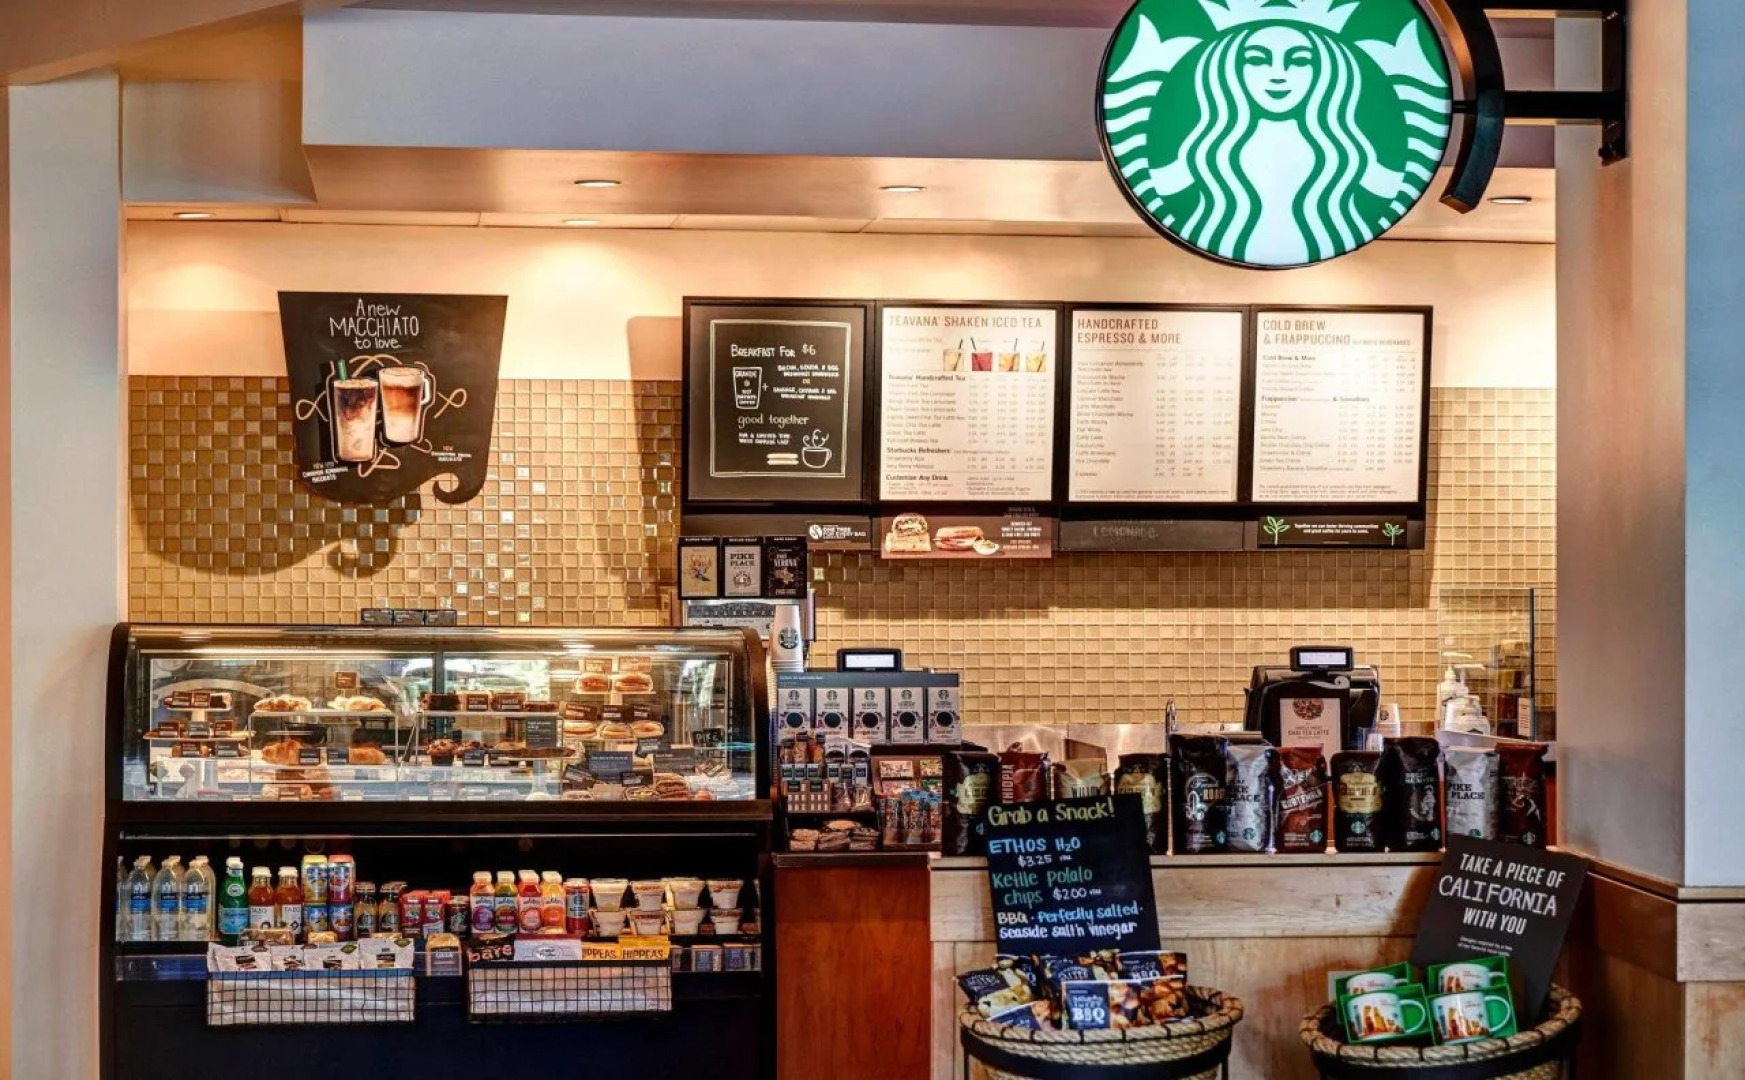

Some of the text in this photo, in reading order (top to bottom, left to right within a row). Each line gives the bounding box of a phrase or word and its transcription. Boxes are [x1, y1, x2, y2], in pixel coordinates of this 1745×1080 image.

[356, 297, 401, 317] A new
[329, 315, 420, 338] MACCHIATO
[944, 315, 989, 328] SHAKEN
[992, 317, 1018, 328] ICED
[1022, 317, 1043, 329] TEA
[1077, 318, 1159, 331] HANDCRAFTED
[1263, 319, 1326, 331] COLD BREW
[354, 336, 372, 350] to
[1077, 332, 1182, 345] ESPRESSO & MORE
[1275, 334, 1351, 346] FRAPPUCCINO
[731, 343, 775, 358] BREAKFAST
[802, 343, 816, 356] $6
[738, 413, 810, 430] good together
[1451, 791, 1486, 800] PLACE
[988, 796, 1115, 826] Grab a Snack!
[989, 838, 1047, 854] ETHOS
[1017, 854, 1052, 868] $3.25
[1459, 853, 1566, 889] TAKE A PIECE OF
[992, 871, 1039, 889] Kettle
[1003, 889, 1044, 910] chips
[1438, 874, 1558, 917] CALIFORNIA
[1462, 906, 1527, 936] WITH YOU
[999, 924, 1048, 940] seaside
[1087, 921, 1138, 941] vinegar
[622, 948, 664, 960] HIPPEAS
[1072, 1007, 1105, 1025] BBQ
